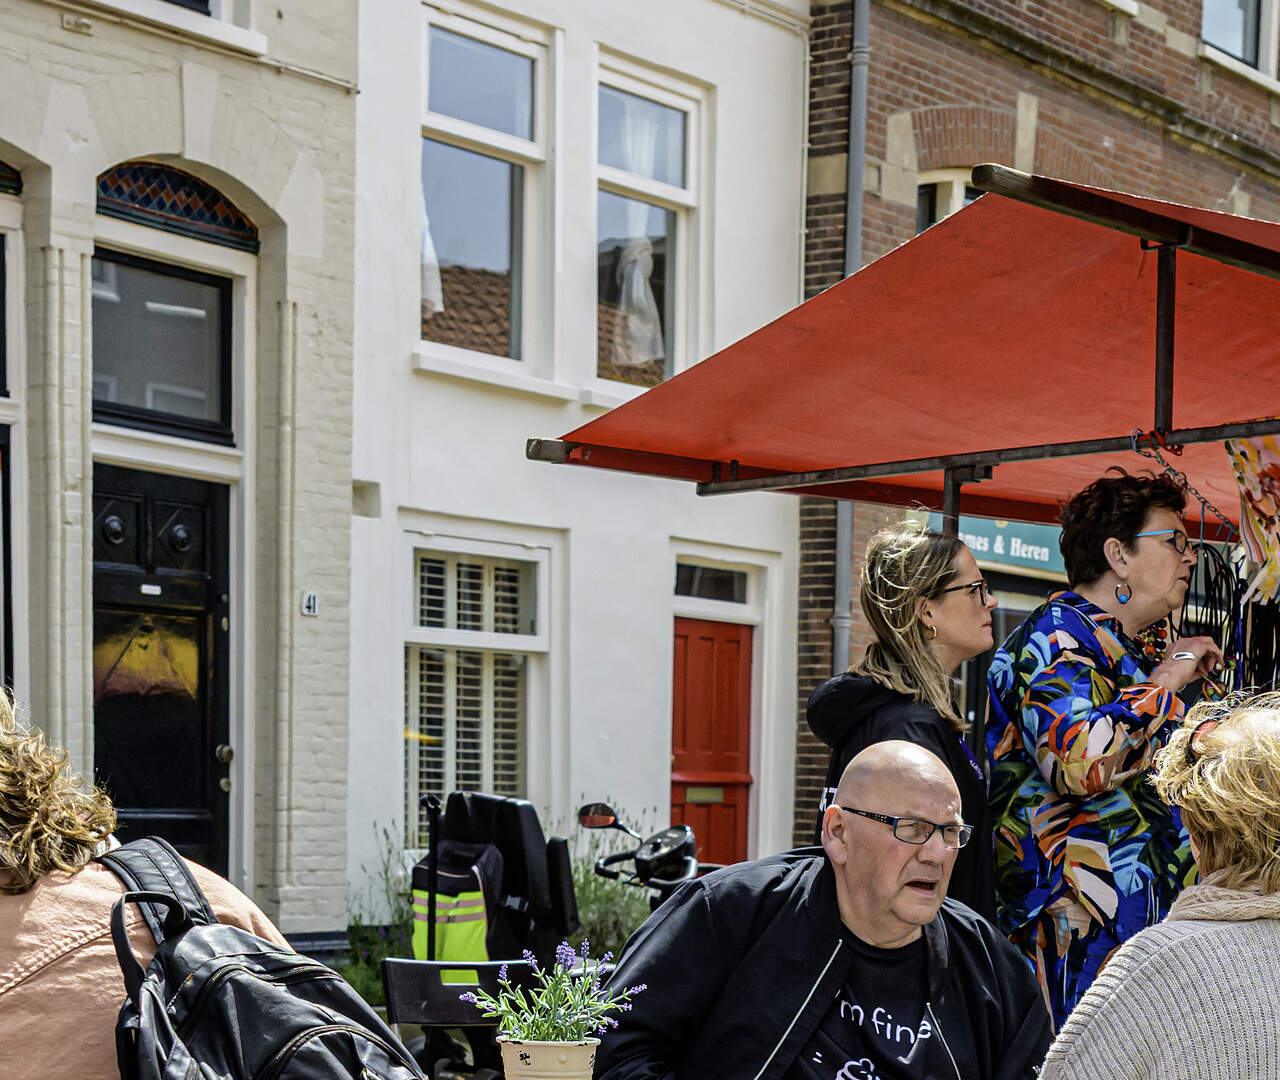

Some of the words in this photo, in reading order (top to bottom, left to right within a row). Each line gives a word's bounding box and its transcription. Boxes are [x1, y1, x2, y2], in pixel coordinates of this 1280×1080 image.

[993, 535, 1005, 555] &
[1010, 537, 1050, 562] Heren
[871, 1007, 932, 1044] fine
